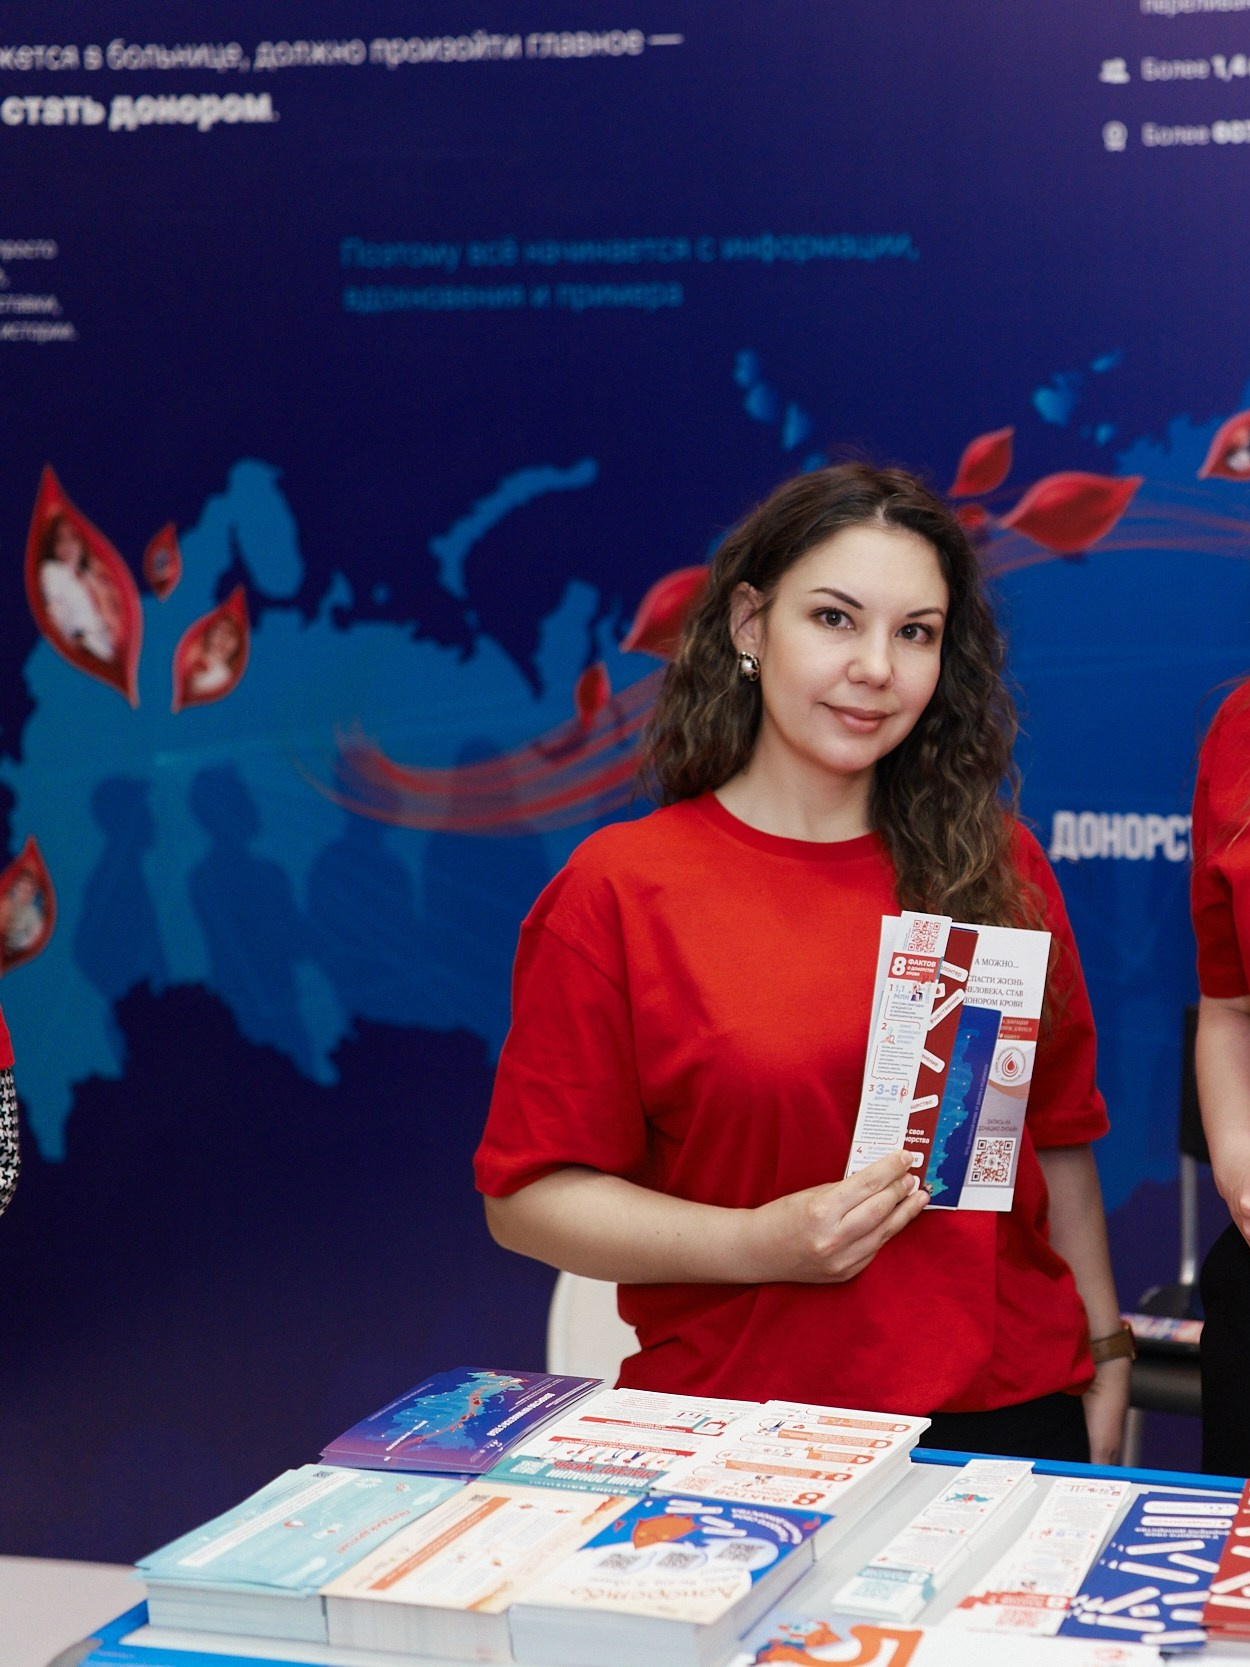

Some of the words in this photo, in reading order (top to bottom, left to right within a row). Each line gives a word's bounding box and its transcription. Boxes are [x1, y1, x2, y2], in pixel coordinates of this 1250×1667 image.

[106, 38, 250, 74] больнице,
[253, 38, 366, 73] должно
[369, 28, 522, 71] произойти
[525, 29, 646, 60] главное
[1, 94, 106, 126] стать
[108, 92, 281, 132] донором.
[1050, 811, 1192, 862] ДОНОРС
[892, 956, 907, 976] 8
[908, 959, 936, 968] ФАКТОВ
[974, 958, 980, 966] А
[997, 978, 1024, 987] ЖИЗНЬ
[1006, 989, 1024, 998] СТАВ
[999, 1000, 1024, 1008] КРОВИ
[792, 1492, 826, 1507] 8
